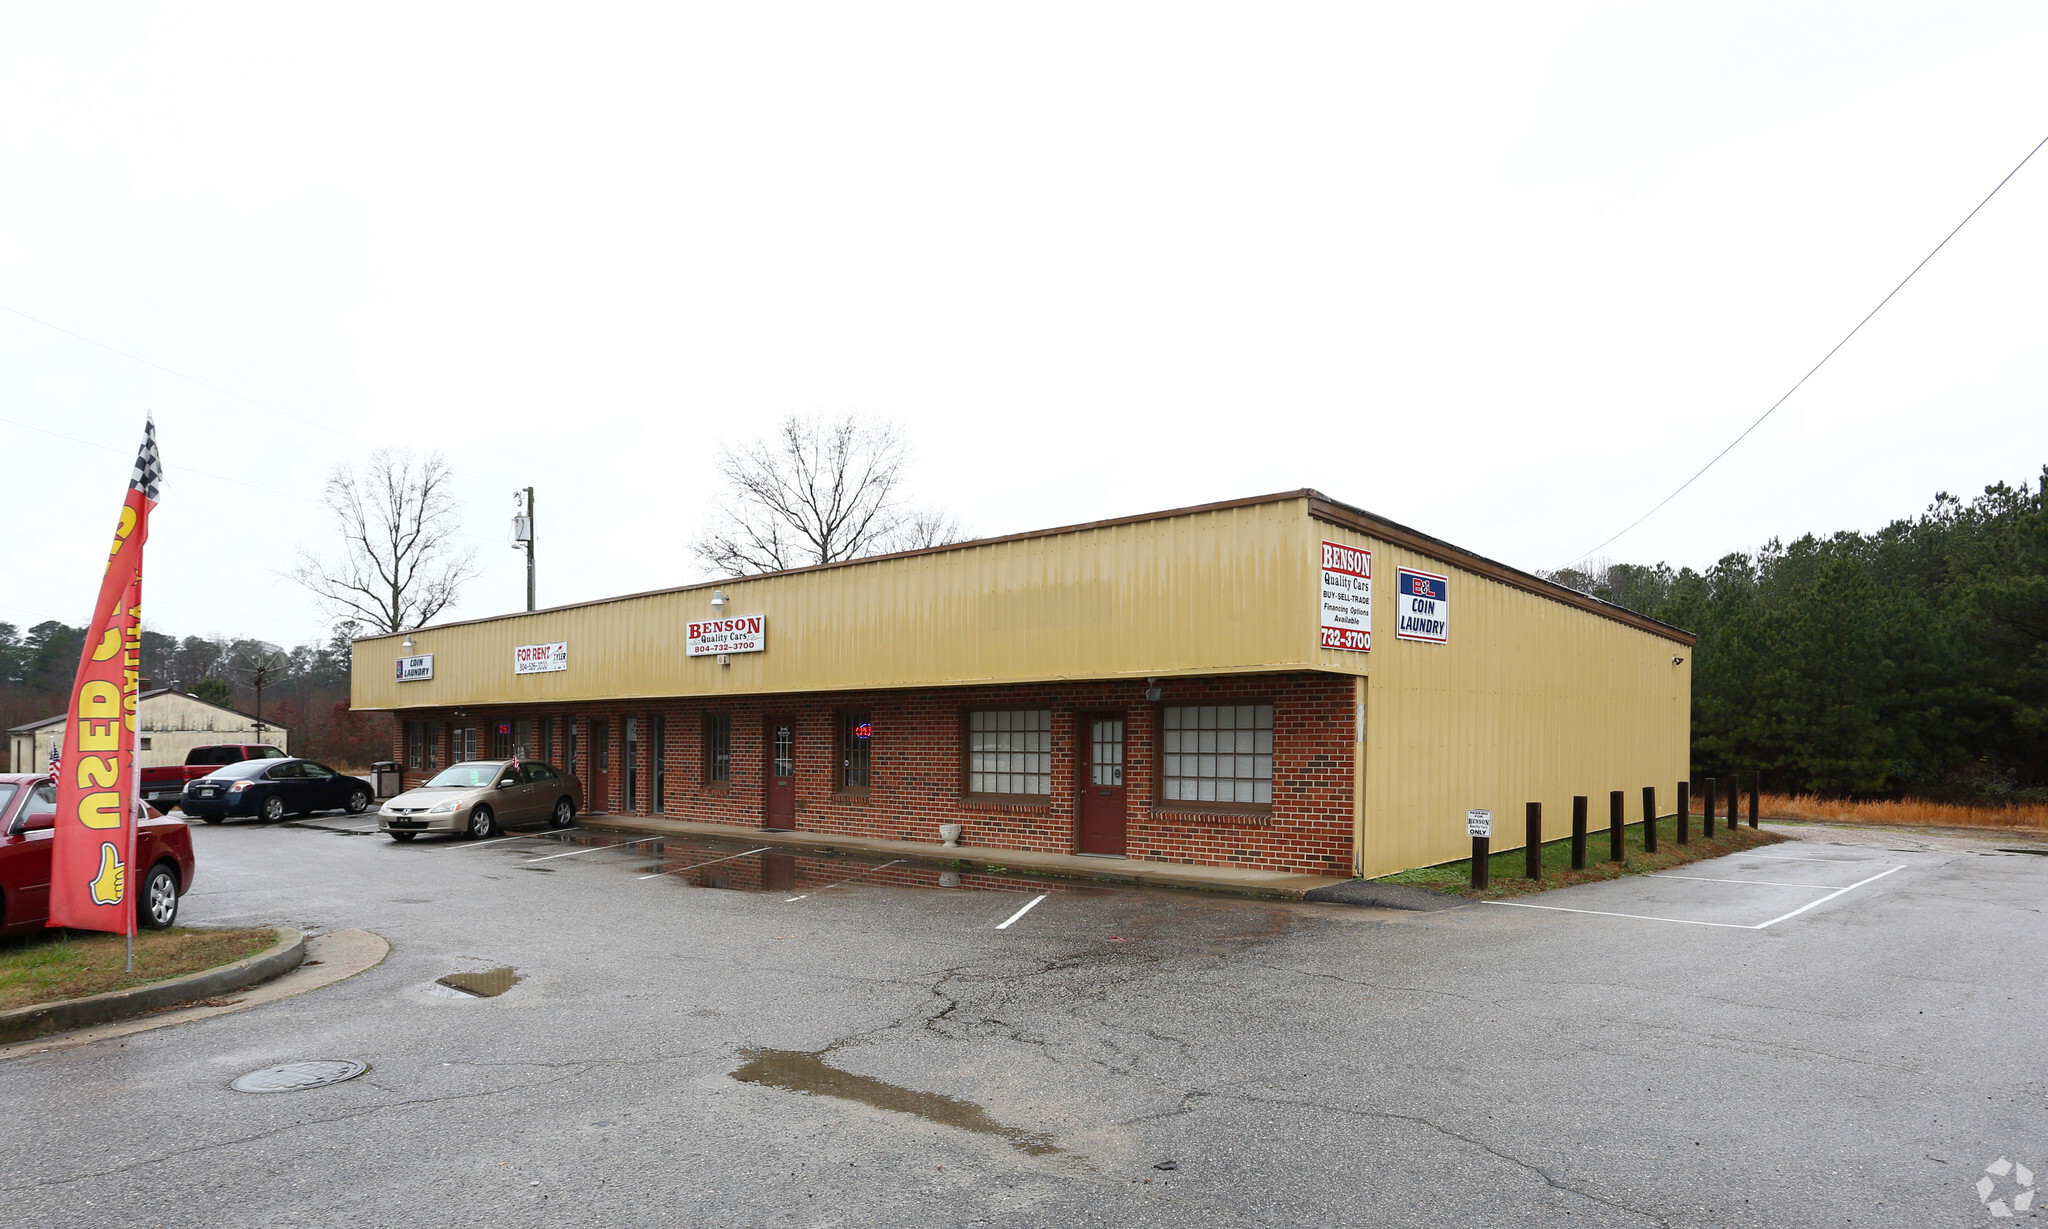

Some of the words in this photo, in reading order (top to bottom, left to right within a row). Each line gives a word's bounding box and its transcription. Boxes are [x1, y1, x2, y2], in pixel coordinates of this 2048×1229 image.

[1322, 544, 1370, 577] BENSON
[1324, 572, 1351, 591] Quality
[1353, 578, 1369, 592] Cars
[1413, 578, 1435, 597] B&L
[1323, 590, 1370, 605] BUY-SELL-TRADE
[1323, 602, 1348, 614] Financing
[1350, 606, 1369, 617] Options
[1412, 598, 1435, 615] COIN
[688, 617, 761, 639] BENSON
[1333, 615, 1360, 625] Available
[1400, 615, 1445, 636] LAUNDRY
[701, 634, 727, 644] Quality
[729, 632, 747, 641] Cars
[1321, 628, 1371, 649] 732-3700
[517, 648, 531, 662] FOR
[532, 646, 551, 661] RENT
[694, 641, 755, 653] 804-732-3700
[410, 658, 423, 667] COIN
[404, 667, 429, 677] LAUNDRY
